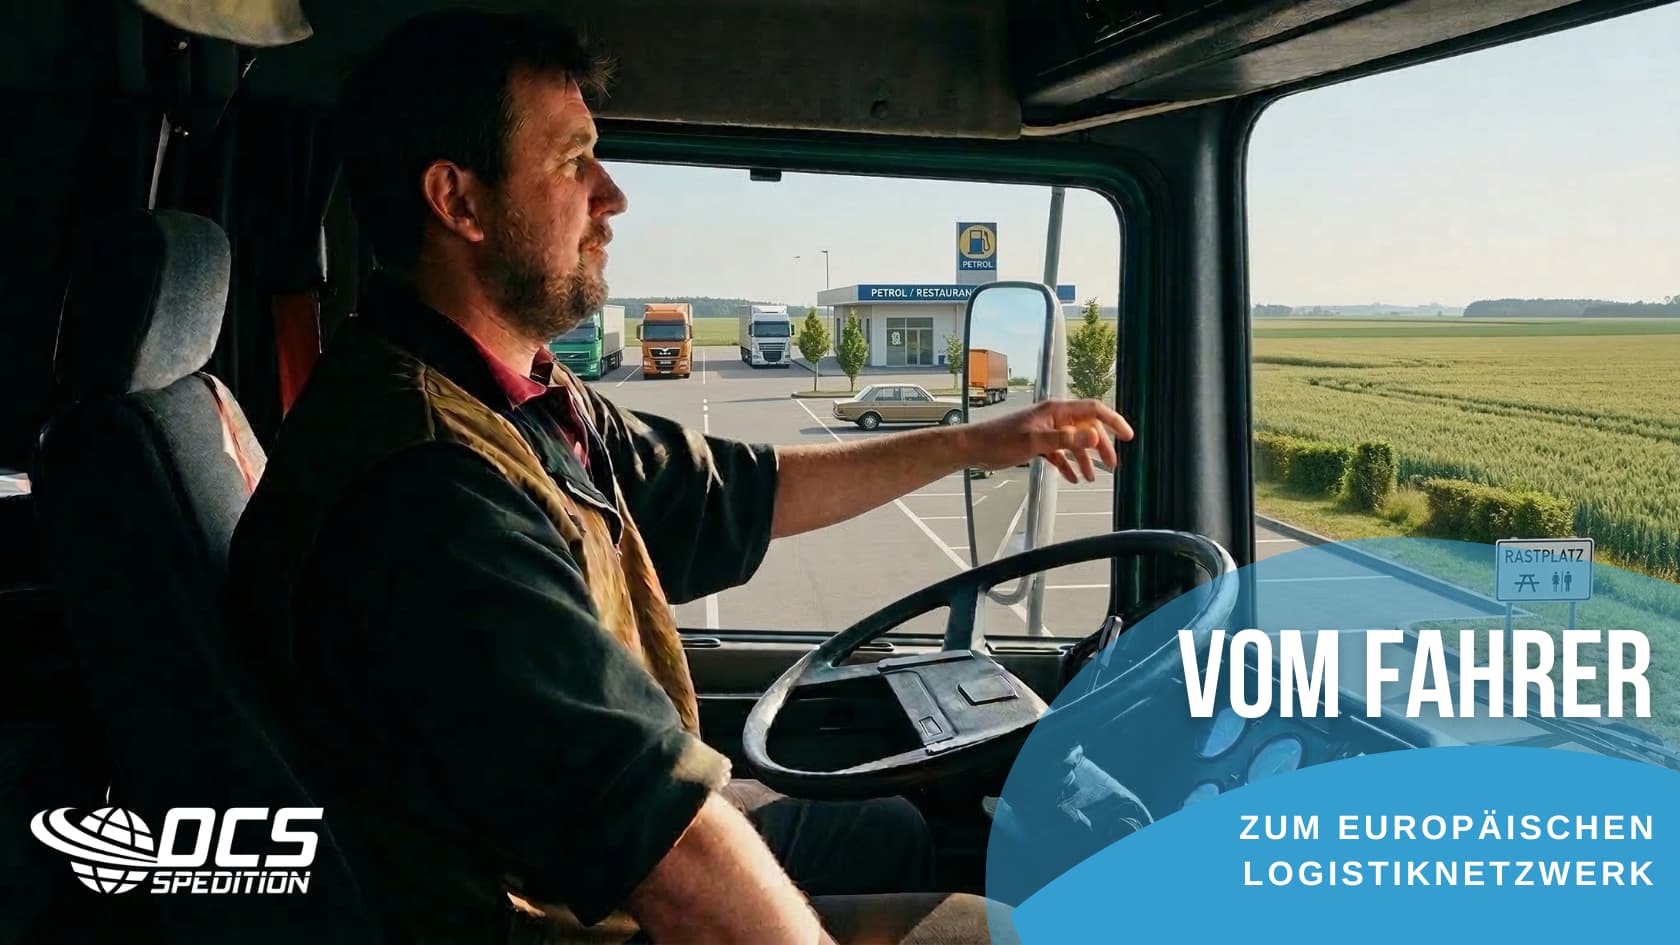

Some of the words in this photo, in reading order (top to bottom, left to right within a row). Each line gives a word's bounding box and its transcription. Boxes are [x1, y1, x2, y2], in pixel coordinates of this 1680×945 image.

[962, 260, 993, 268] PETROL
[871, 288, 908, 297] PETROL
[916, 287, 976, 297] RESTAURAN
[1505, 548, 1584, 564] RASTPLATZ
